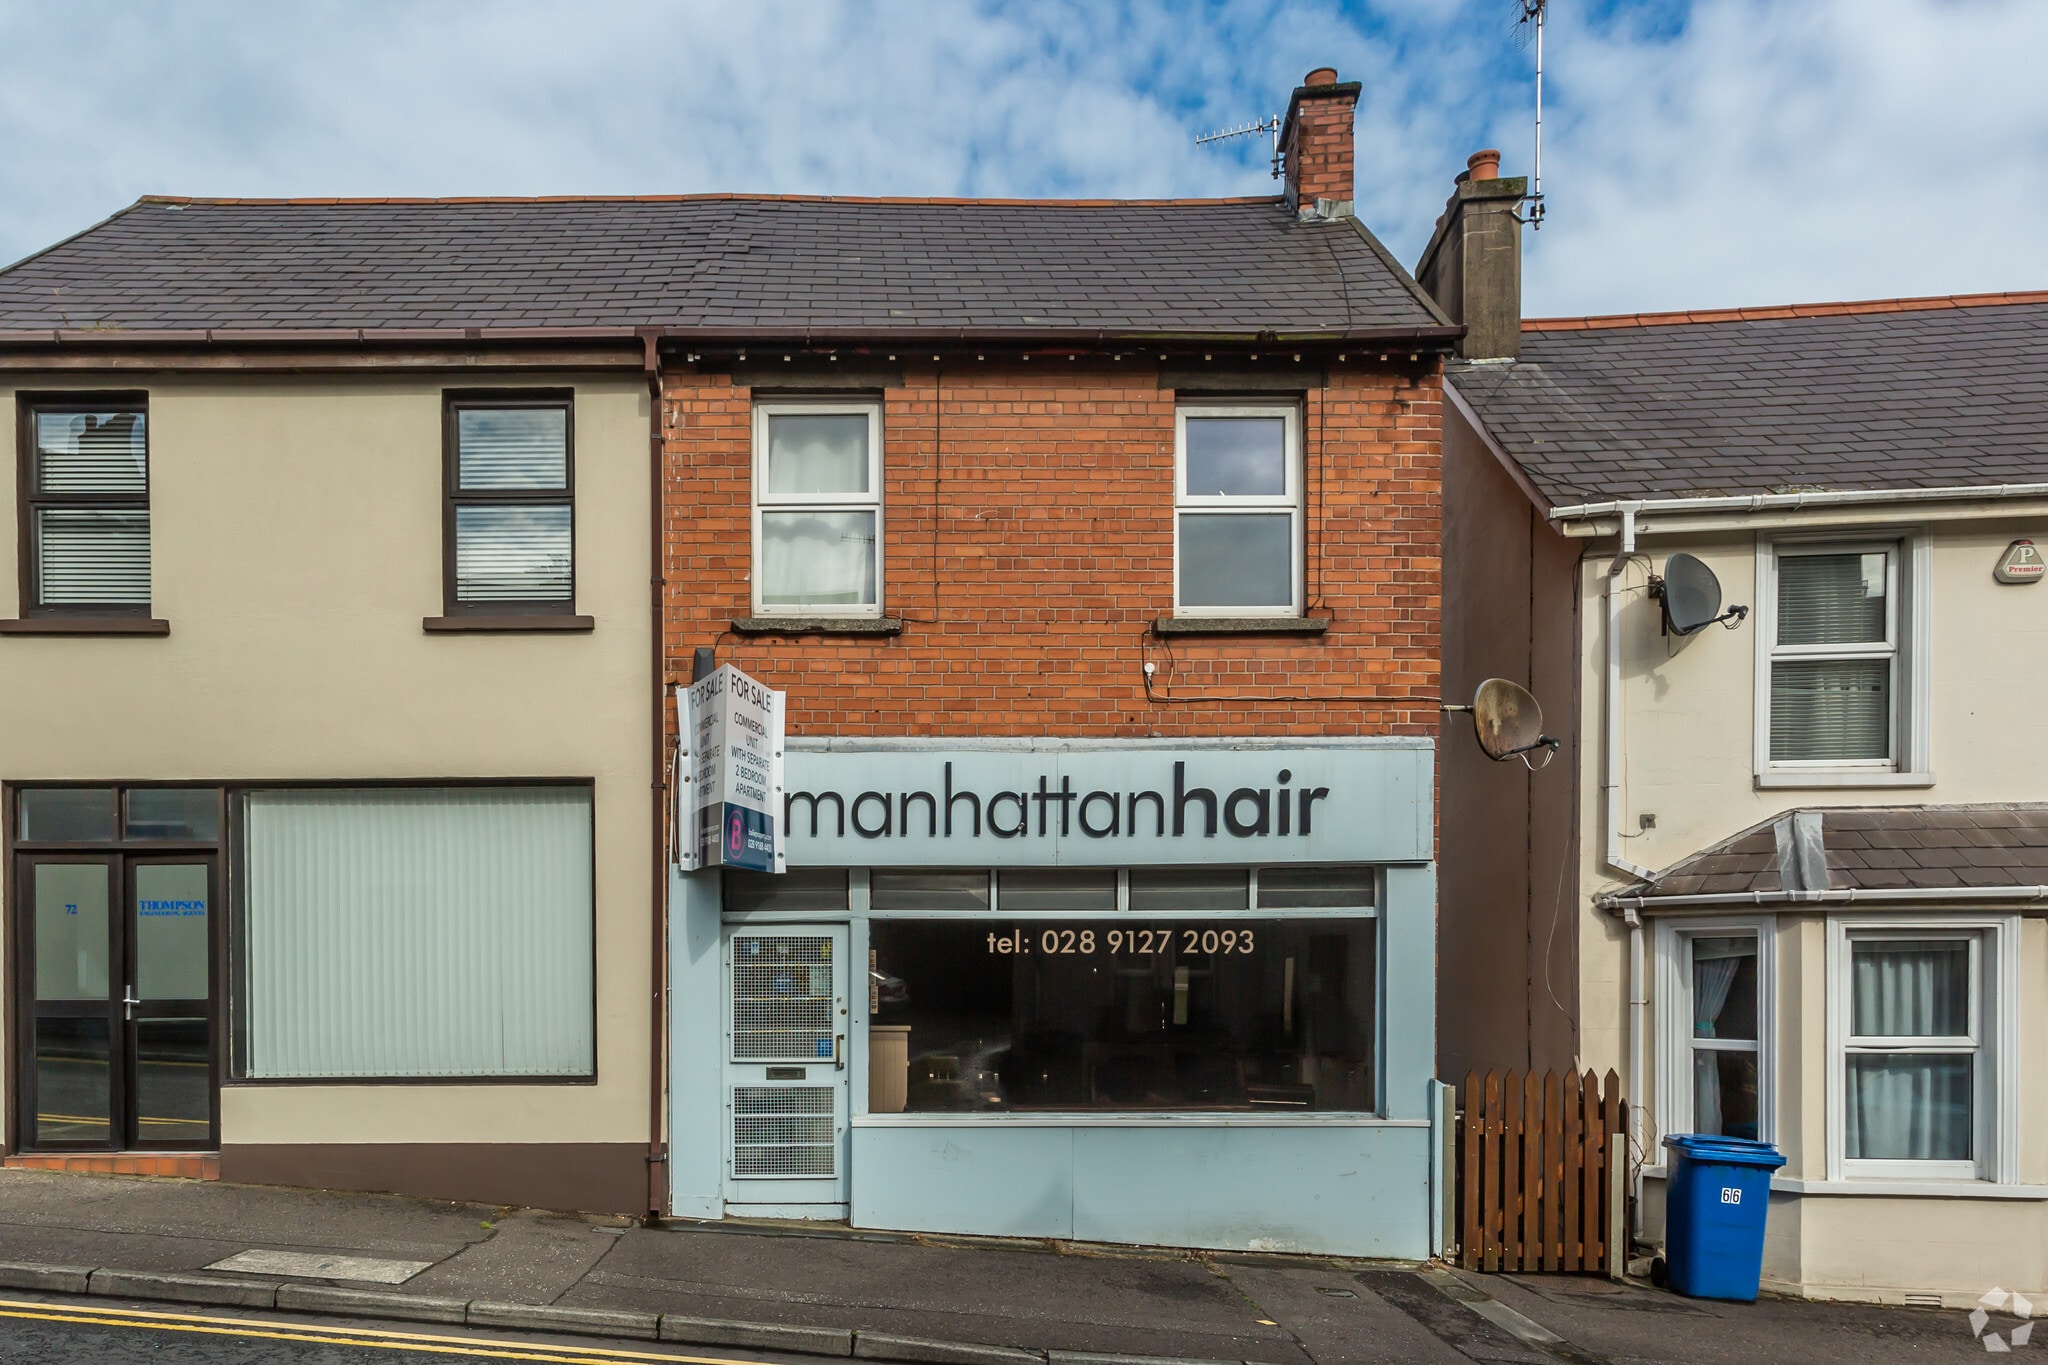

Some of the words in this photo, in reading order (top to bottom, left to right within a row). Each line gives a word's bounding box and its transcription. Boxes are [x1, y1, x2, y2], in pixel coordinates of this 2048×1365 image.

[691, 685, 704, 710] FOR
[706, 673, 723, 701] SALE
[731, 673, 749, 701] FOR
[751, 685, 771, 713] SALE
[734, 711, 768, 738] COMMERCIAL
[745, 733, 759, 749] UNIT
[731, 745, 746, 759] WITH
[746, 751, 770, 772] SEPARATE
[735, 764, 741, 776] 2
[740, 766, 767, 787] BEDROOM
[735, 782, 766, 802] APARTMENT
[731, 818, 742, 851] B
[65, 904, 78, 915] 72
[139, 900, 205, 910] THOMPSON
[986, 929, 1030, 955] tel:
[1041, 929, 1096, 955] 028
[1108, 929, 1173, 955] 9127
[1183, 929, 1255, 955] 2093
[1722, 1189, 1740, 1203] 66
